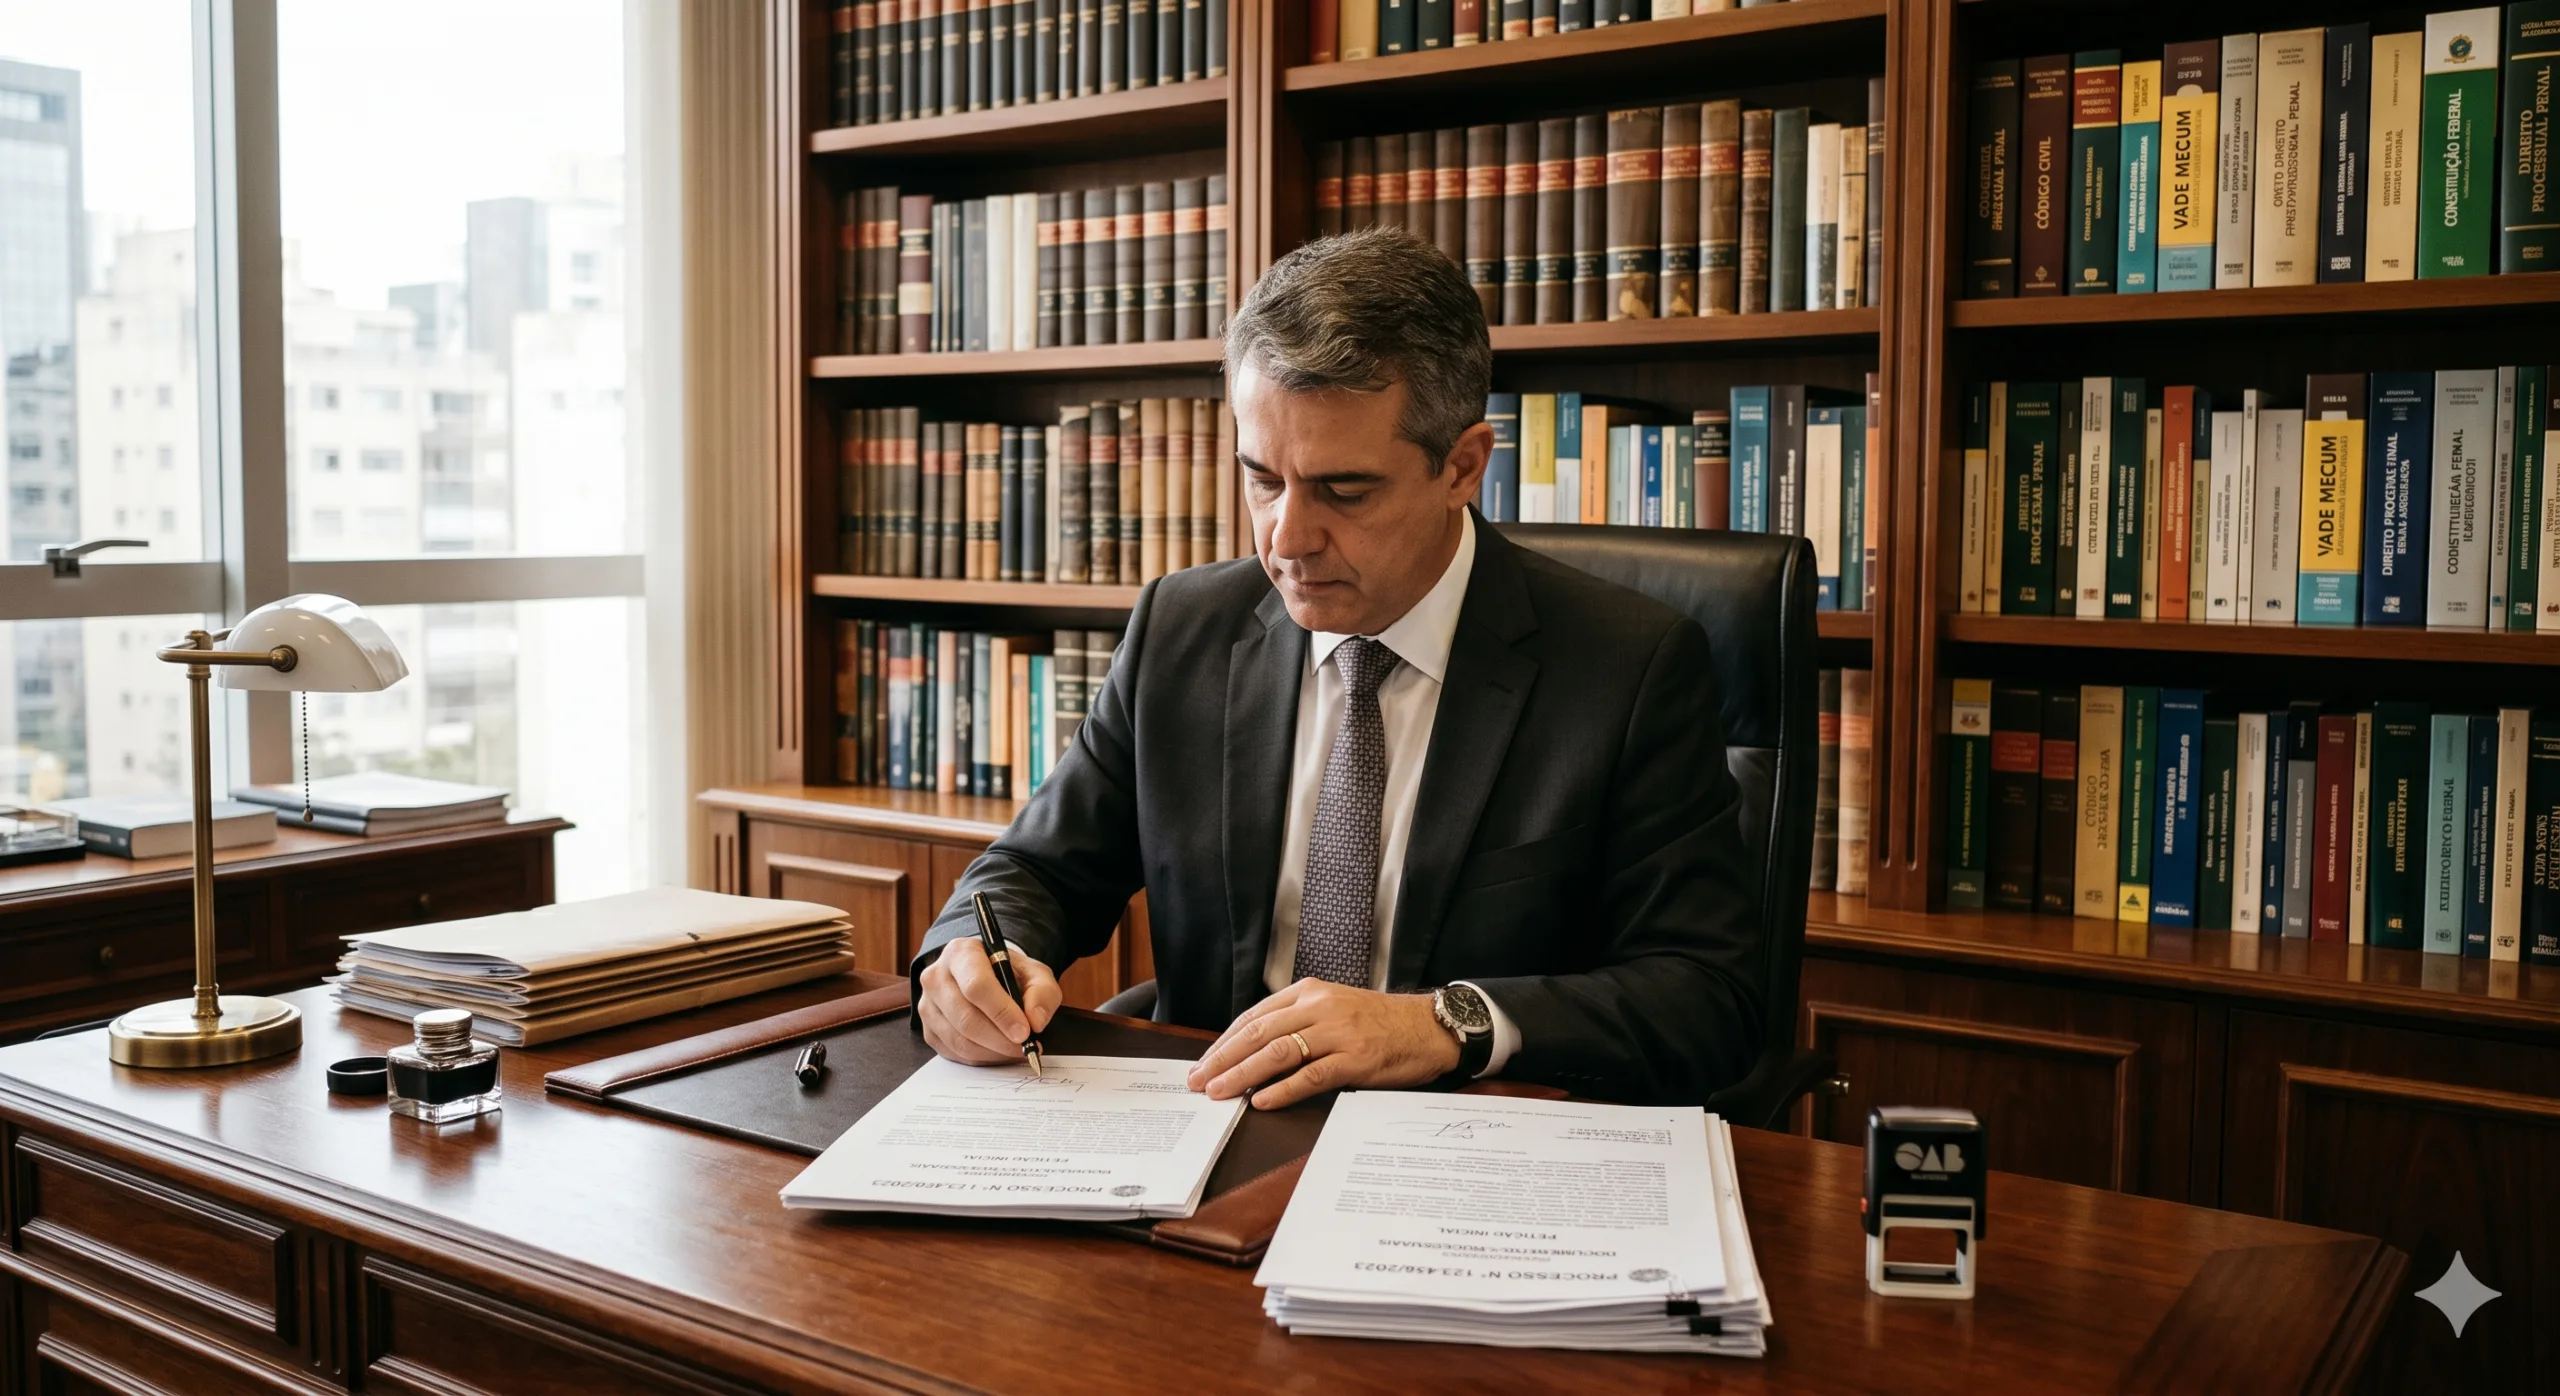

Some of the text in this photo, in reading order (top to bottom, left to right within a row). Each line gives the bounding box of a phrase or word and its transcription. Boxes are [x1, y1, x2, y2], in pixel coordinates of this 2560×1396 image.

[2289, 81, 2301, 120] PENAL
[2447, 88, 2463, 141] FEDERAL
[2034, 136, 2051, 229] CÓDIGO CIVIL
[2174, 110, 2191, 230] VADE MECUM
[2317, 435, 2338, 557] VADE MECUM
[2382, 528, 2395, 576] DIREITO
[1895, 1142, 1965, 1172] OAB
[1437, 1227, 1489, 1236] INICIAL
[1507, 1270, 1619, 1281] PROCESSO
